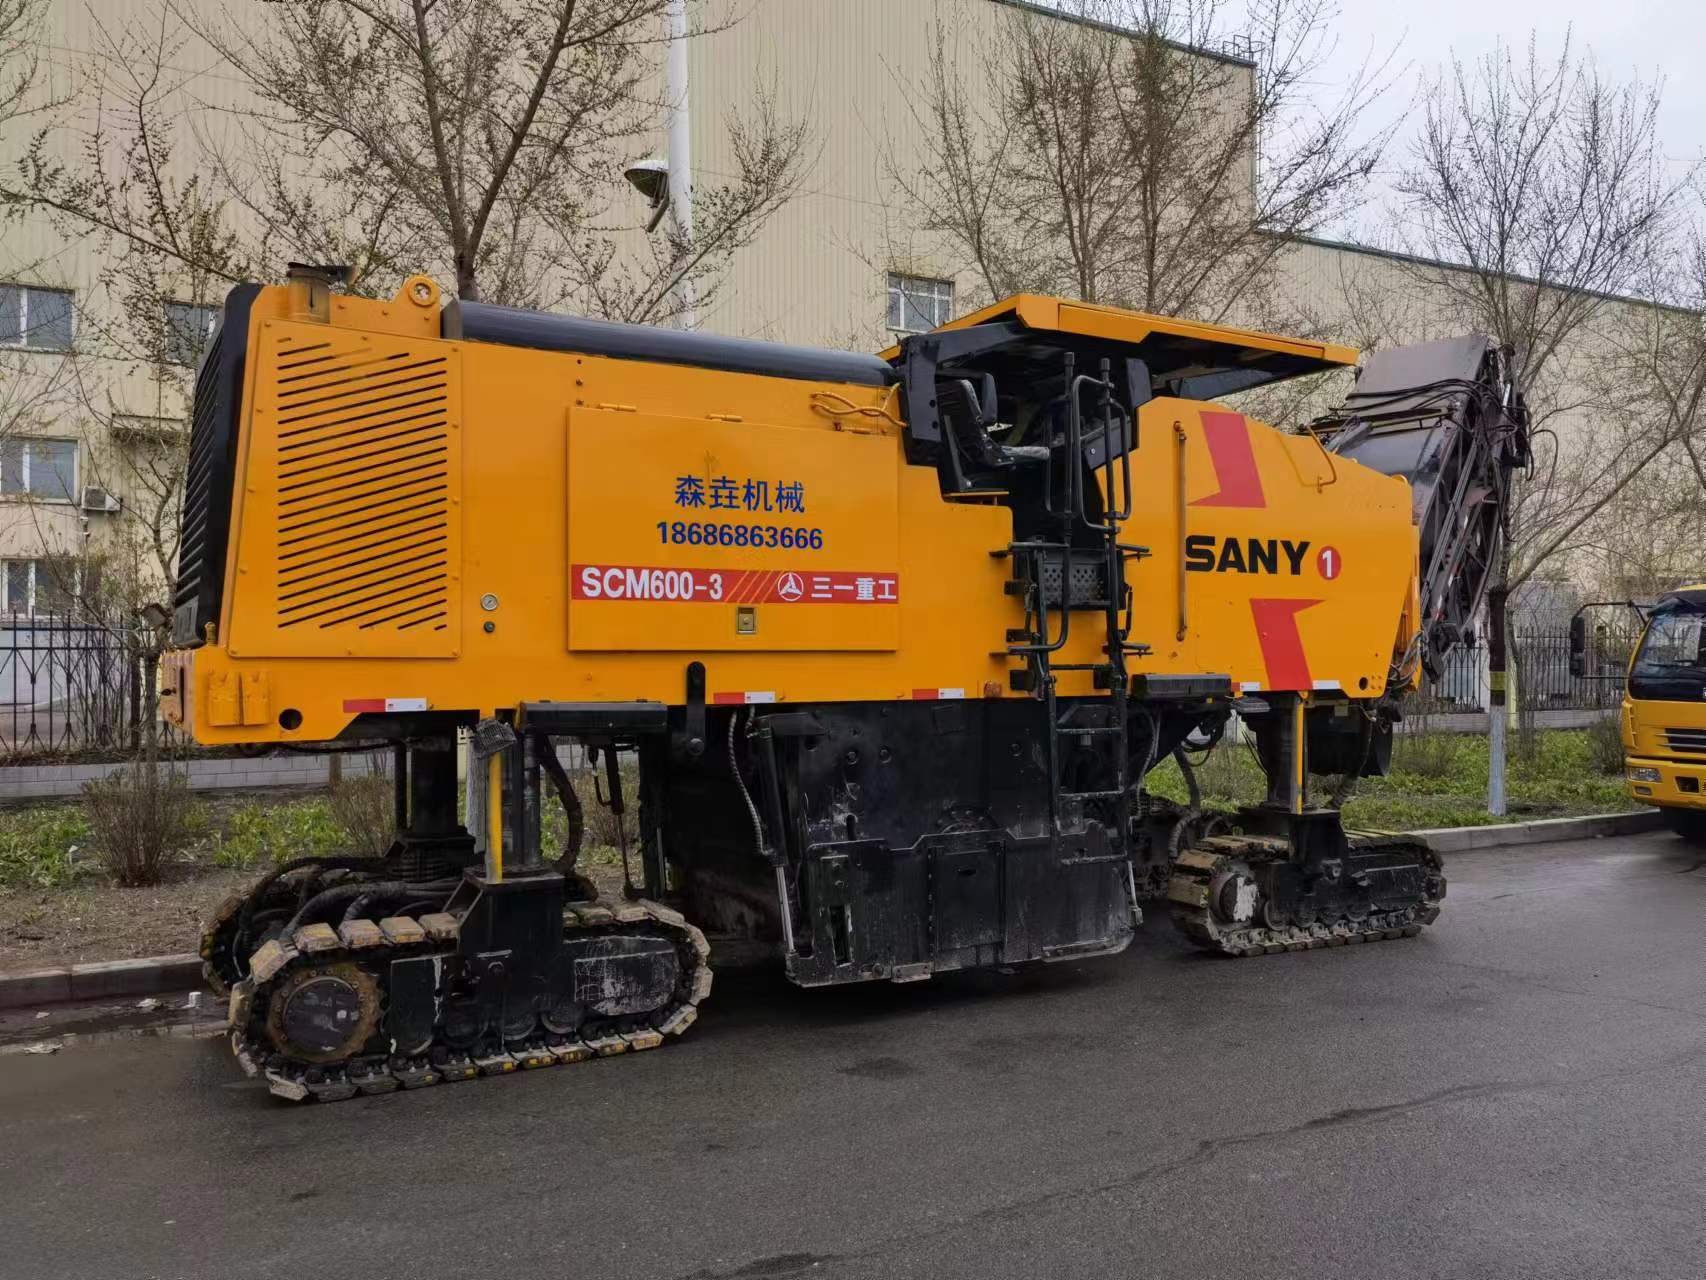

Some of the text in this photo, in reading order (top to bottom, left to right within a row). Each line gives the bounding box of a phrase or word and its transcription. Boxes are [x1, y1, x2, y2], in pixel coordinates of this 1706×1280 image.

[675, 475, 805, 513] 森垚机械
[656, 521, 823, 550] 18686863666
[1185, 535, 1311, 576] SANY
[1322, 549, 1333, 578] 1
[582, 567, 723, 600] SCM600-3
[811, 577, 897, 600] 三一重工
